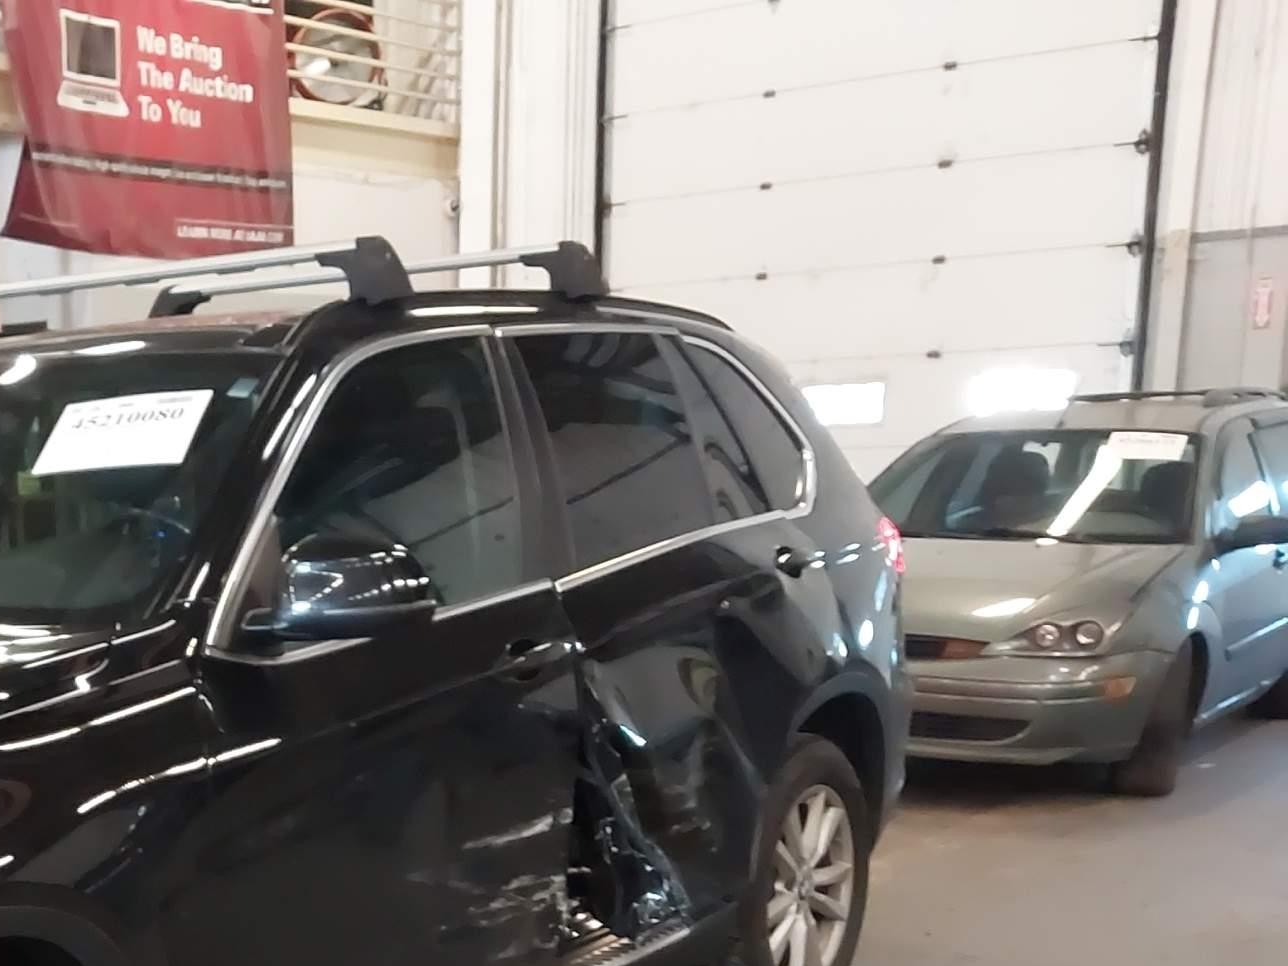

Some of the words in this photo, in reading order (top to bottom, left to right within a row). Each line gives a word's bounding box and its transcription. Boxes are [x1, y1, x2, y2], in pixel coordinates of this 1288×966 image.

[137, 25, 167, 56] We
[169, 32, 223, 71] Bring
[137, 61, 174, 90] The
[179, 68, 254, 103] Auction
[137, 95, 162, 122] To
[167, 98, 202, 128] You
